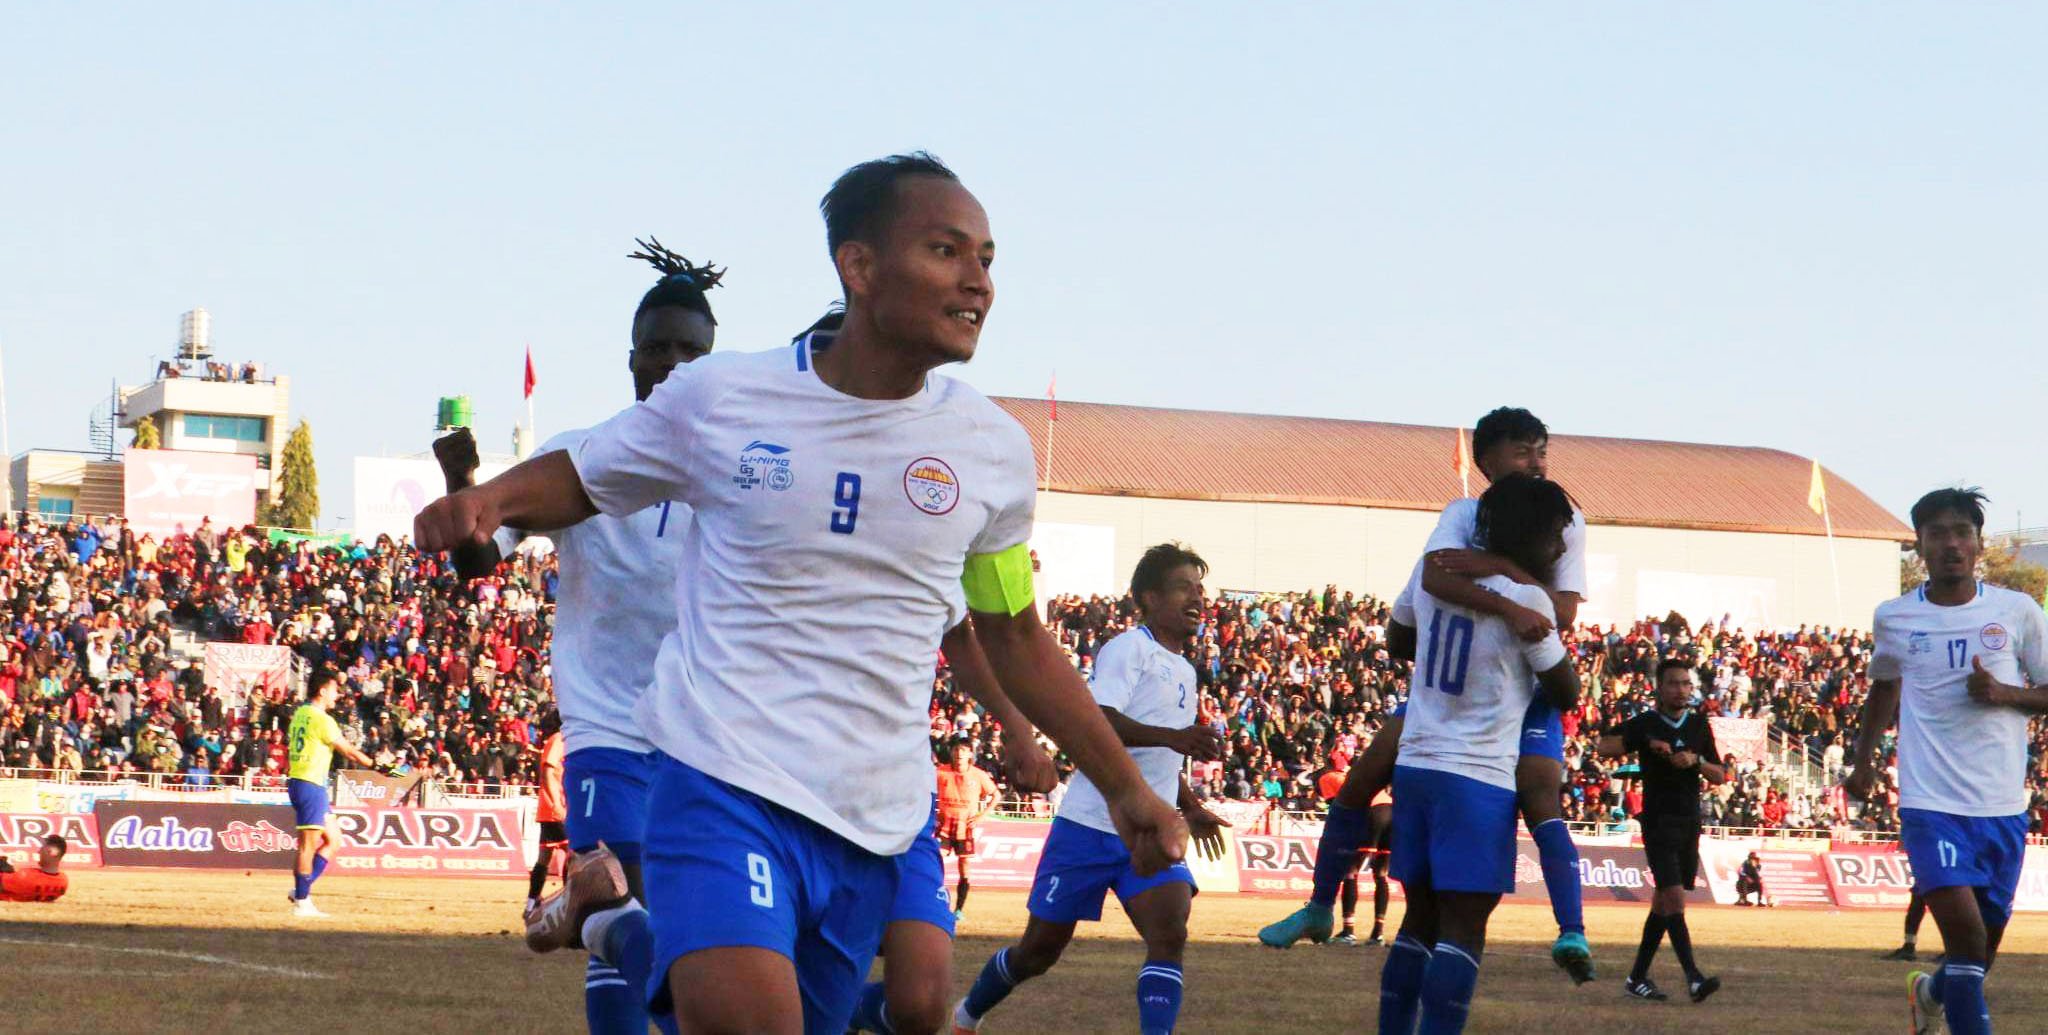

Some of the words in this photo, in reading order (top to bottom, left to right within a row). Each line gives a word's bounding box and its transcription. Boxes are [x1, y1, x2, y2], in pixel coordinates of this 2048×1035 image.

[740, 455, 791, 467] LI-NING
[830, 472, 862, 534] 9
[1425, 608, 1474, 697] 10
[1947, 638, 1967, 669] 17
[1178, 683, 1186, 709] 2
[293, 727, 305, 753] 16
[581, 777, 596, 818] 7
[106, 815, 213, 852] Aaha
[332, 808, 517, 850] RARA
[1937, 840, 1958, 868] 17
[747, 852, 775, 909] 9
[1045, 875, 1060, 903] 2
